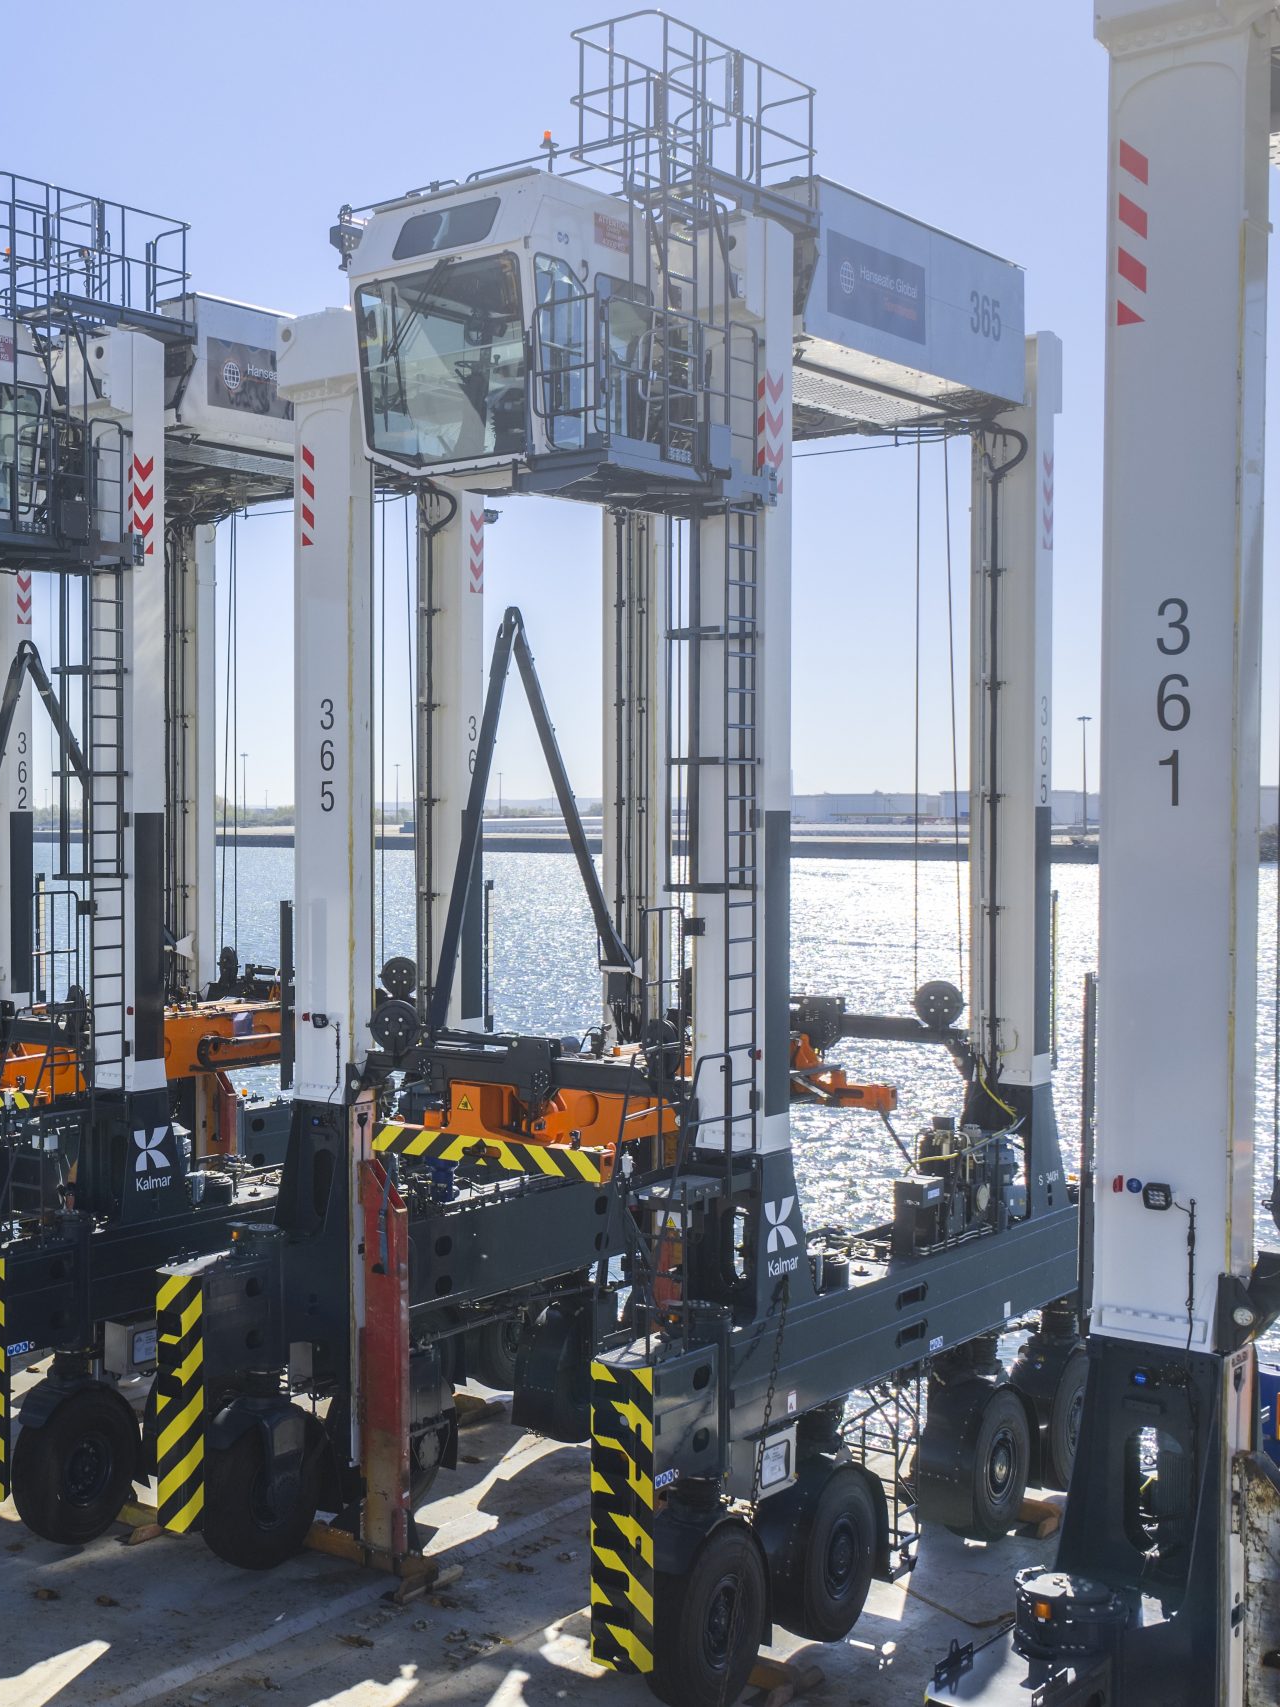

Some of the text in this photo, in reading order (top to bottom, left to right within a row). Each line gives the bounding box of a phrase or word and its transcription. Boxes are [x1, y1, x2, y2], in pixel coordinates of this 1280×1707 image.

[860, 264, 918, 298] Hanseatic Global
[970, 290, 1001, 342] 365
[247, 363, 278, 380] Hansea
[1156, 597, 1191, 807] 361
[17, 731, 27, 809] 362
[320, 698, 335, 812] 365
[1040, 695, 1048, 804] 365
[136, 1175, 172, 1192] Kalmar
[767, 1255, 799, 1278] Kalmar
